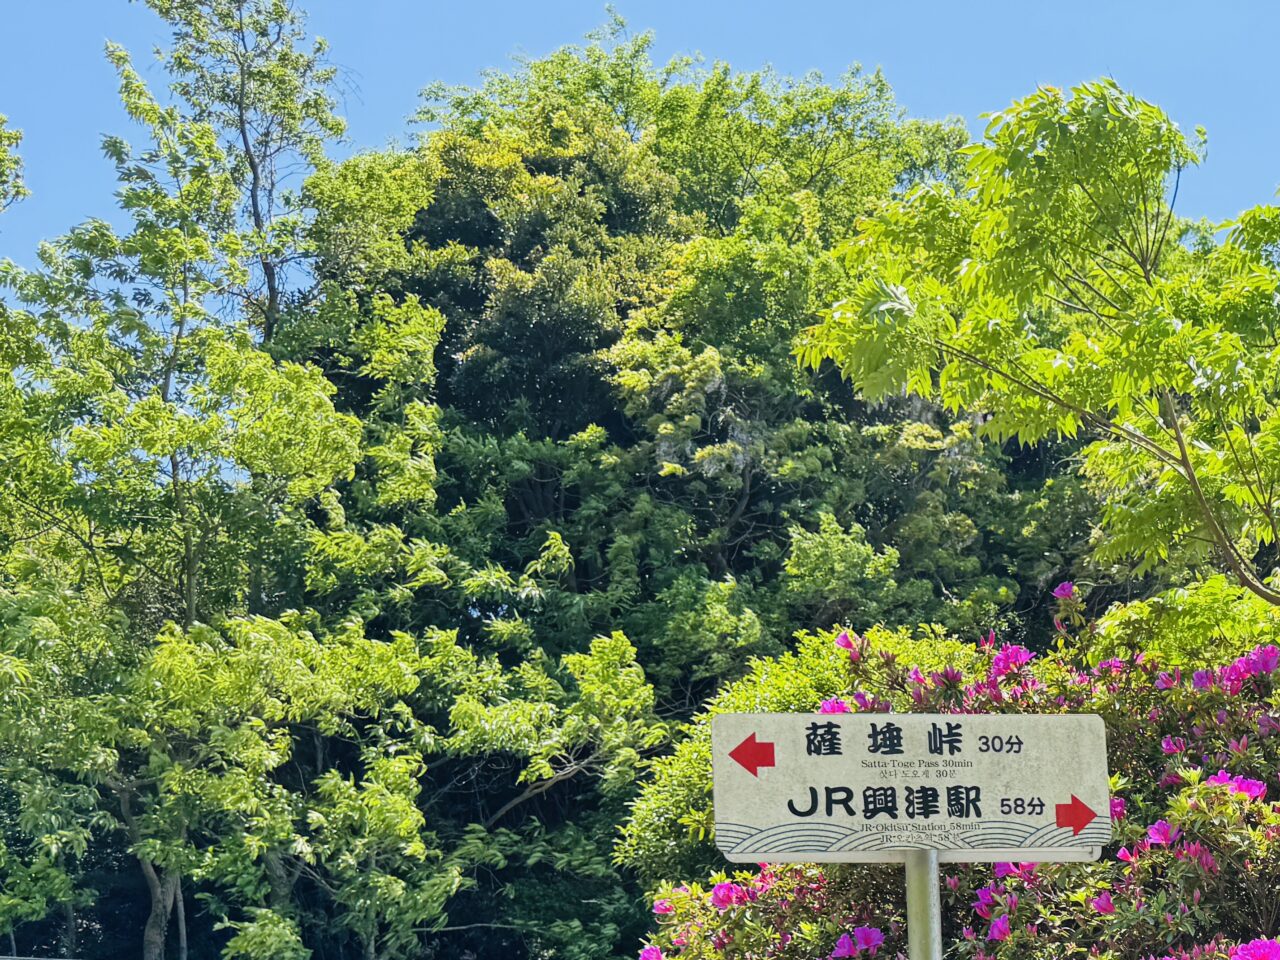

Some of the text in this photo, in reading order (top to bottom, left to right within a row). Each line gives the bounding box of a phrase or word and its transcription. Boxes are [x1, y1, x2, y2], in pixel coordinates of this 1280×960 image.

[977, 735, 1024, 754] 30分
[918, 759, 940, 768] Pass
[942, 759, 973, 768] 30min
[787, 785, 1046, 820] JR興津駅 58分
[911, 822, 946, 832] Station
[949, 821, 981, 831] 58min
